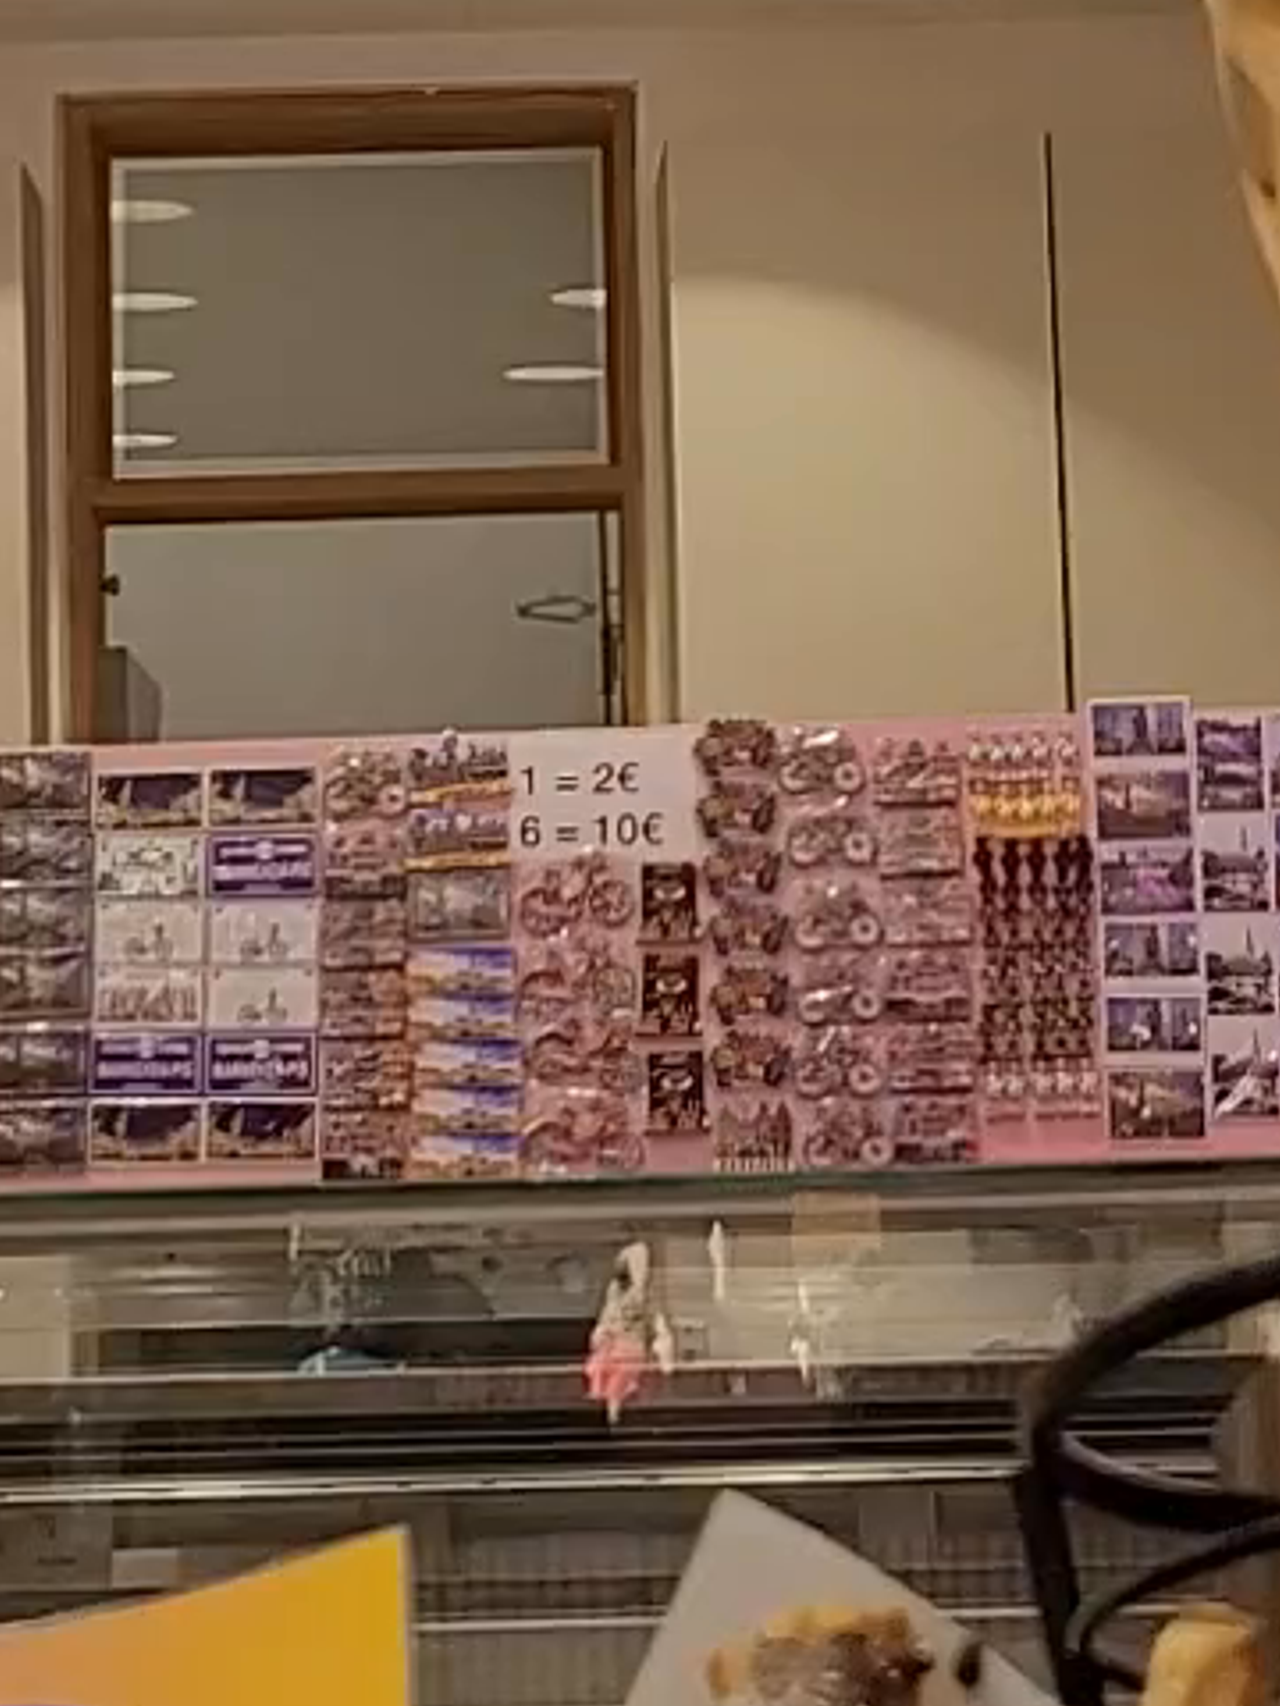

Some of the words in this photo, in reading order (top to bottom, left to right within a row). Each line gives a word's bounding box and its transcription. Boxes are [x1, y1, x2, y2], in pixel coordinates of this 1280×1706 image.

[520, 765, 535, 796] 1
[591, 761, 641, 796] 2€
[520, 815, 542, 848] 6
[592, 811, 665, 847] 10€
